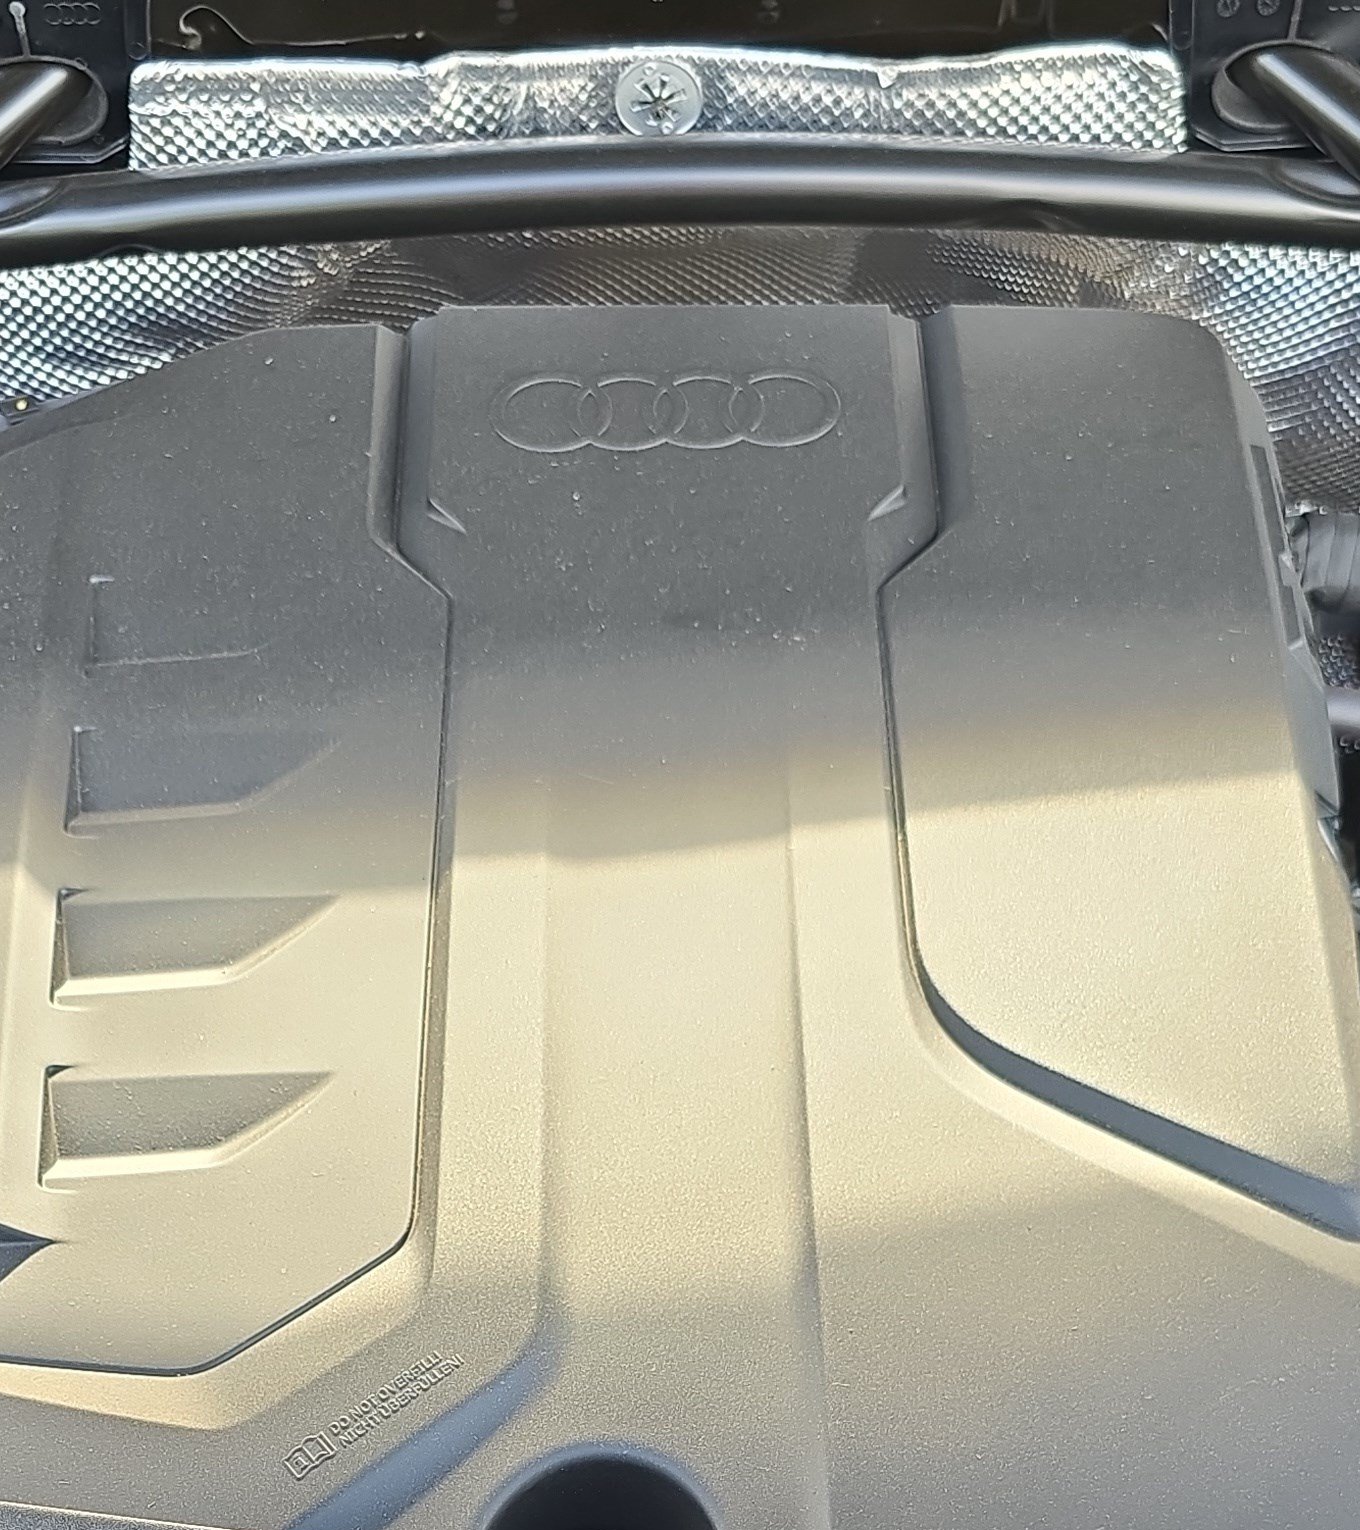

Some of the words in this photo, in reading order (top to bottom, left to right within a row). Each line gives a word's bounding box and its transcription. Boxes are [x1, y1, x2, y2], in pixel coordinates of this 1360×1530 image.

[328, 1415, 350, 1437] DO
[348, 1394, 381, 1423] NOT
[339, 1410, 382, 1449] NICHT
